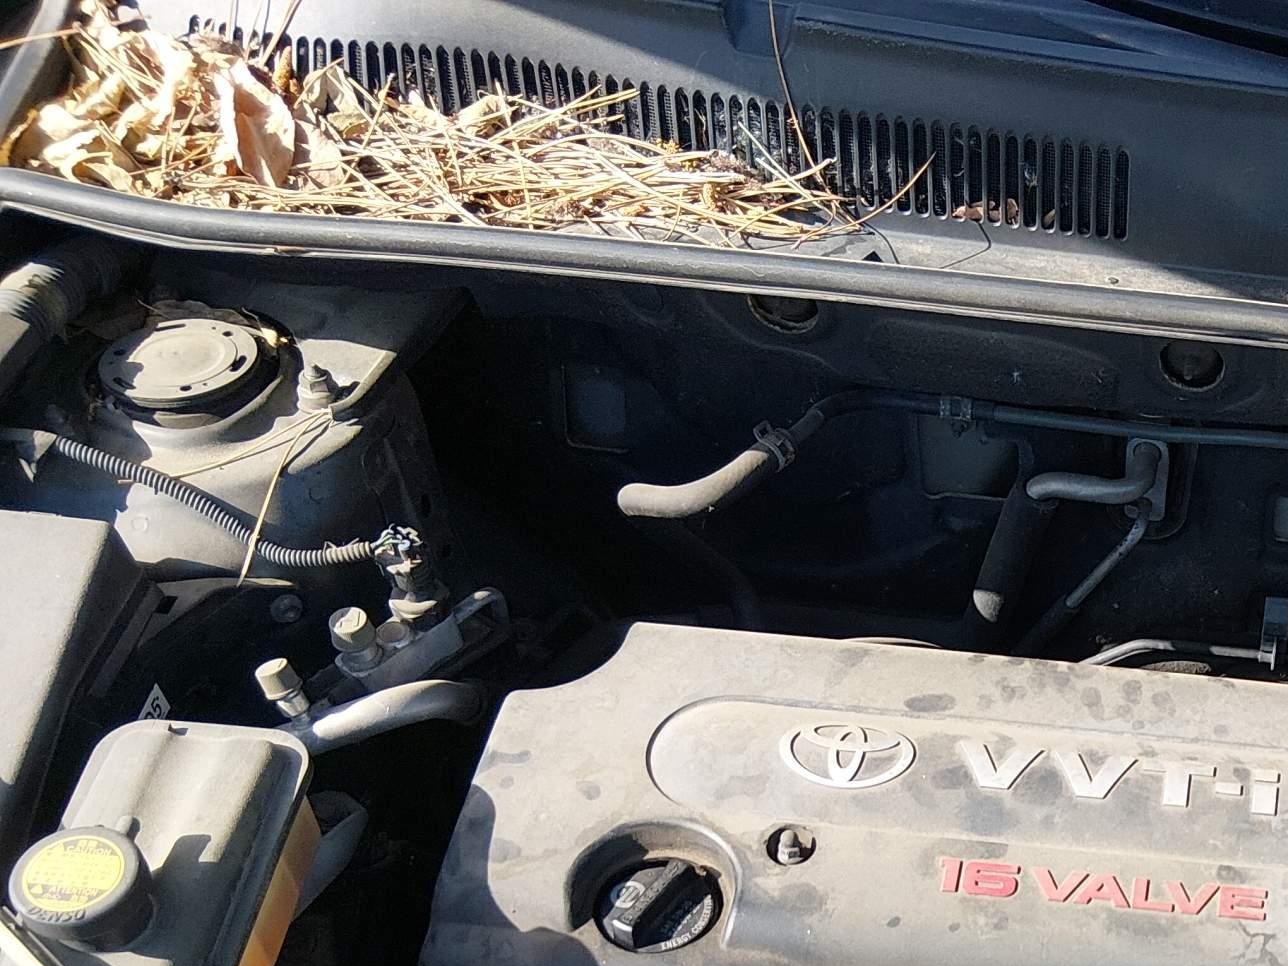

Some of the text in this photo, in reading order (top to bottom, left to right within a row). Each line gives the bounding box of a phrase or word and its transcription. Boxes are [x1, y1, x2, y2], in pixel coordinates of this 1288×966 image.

[958, 738, 1280, 817] VVT-i
[66, 845, 112, 857] CAUTION
[940, 856, 1269, 921] 16 VALVE
[28, 906, 87, 922] DENSO
[661, 931, 692, 951] ENERGY
